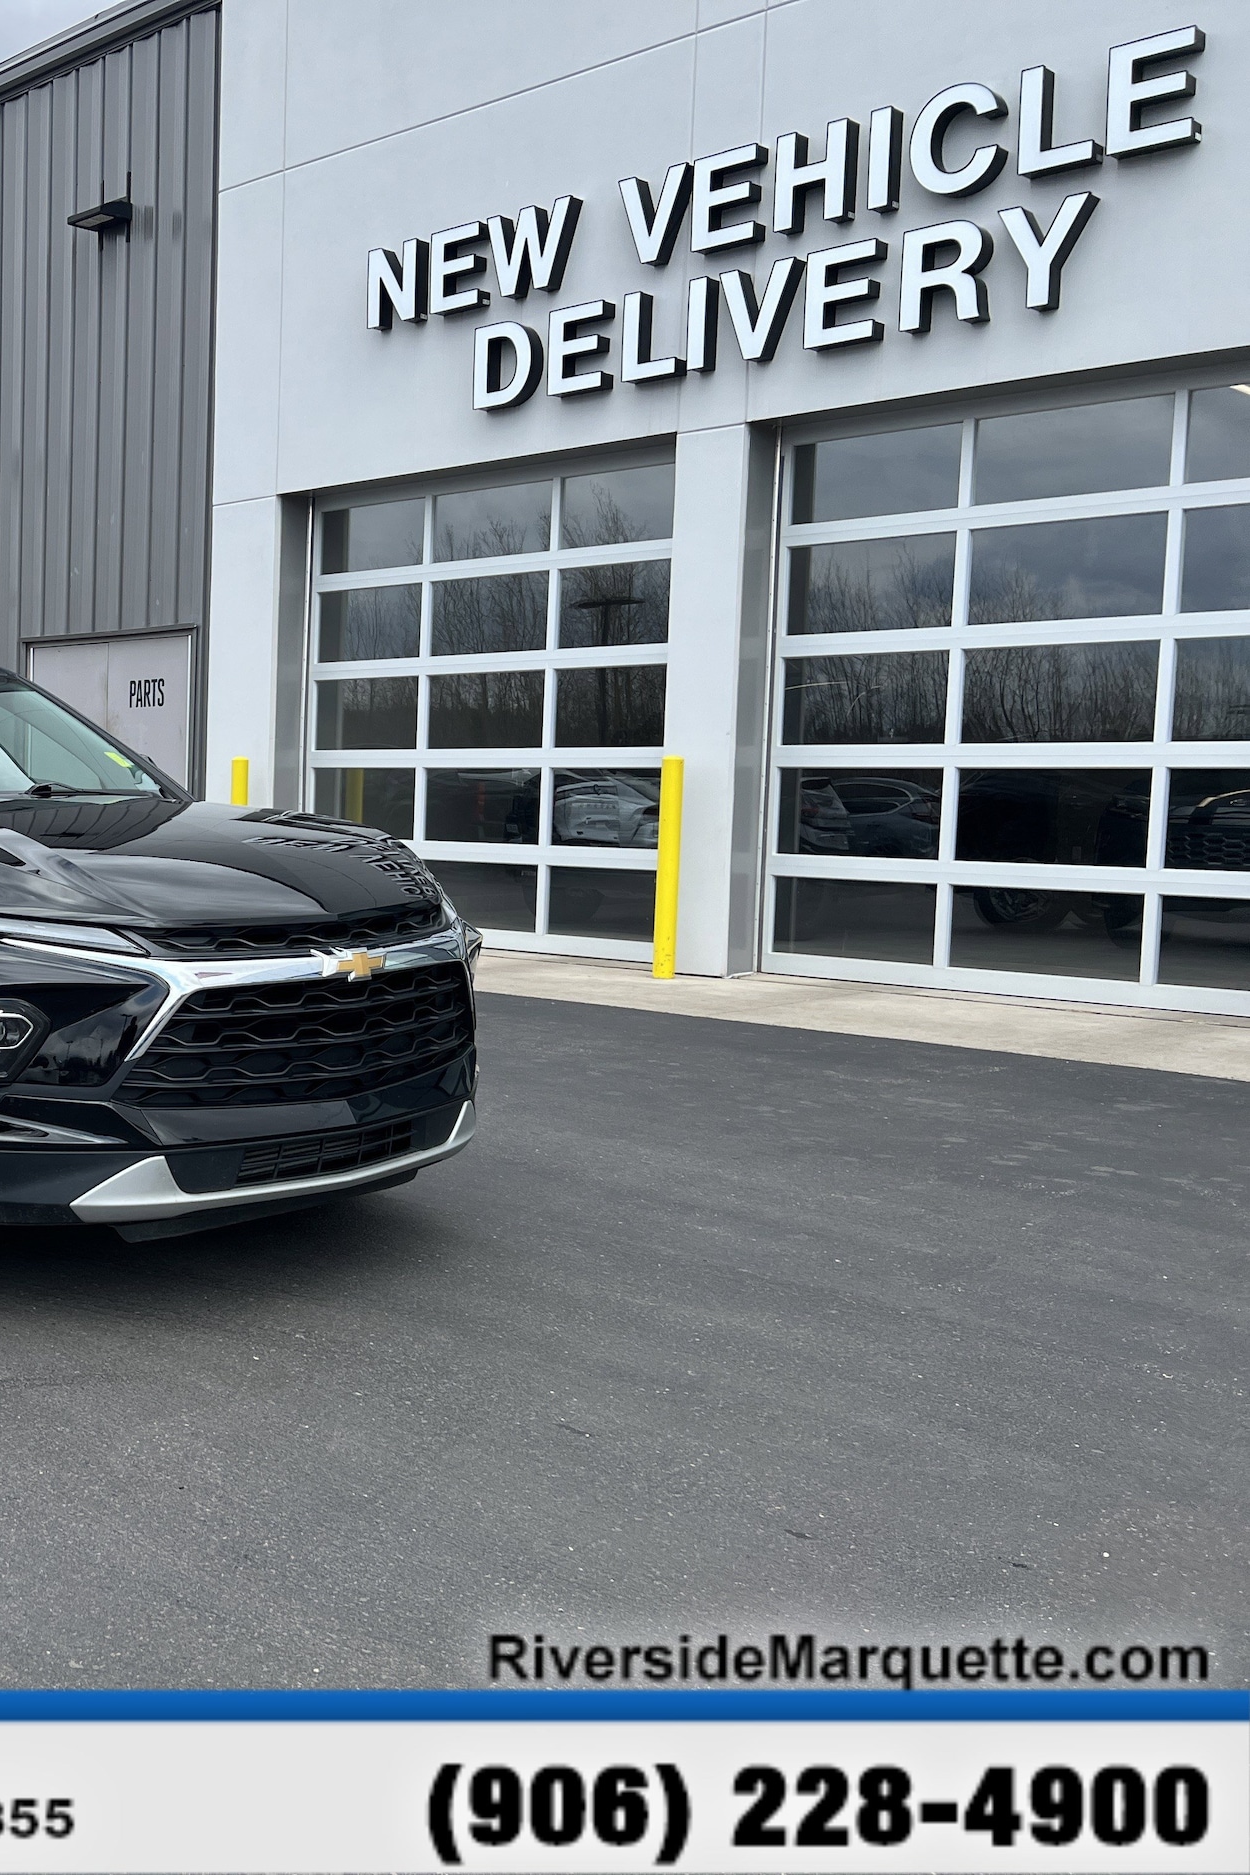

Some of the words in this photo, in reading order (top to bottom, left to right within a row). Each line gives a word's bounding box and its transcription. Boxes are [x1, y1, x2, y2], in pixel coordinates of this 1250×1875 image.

[365, 195, 584, 331] NEW
[618, 24, 1207, 267] VEHICLE
[472, 191, 1100, 412] DELIVERY
[129, 678, 165, 708] PARTS
